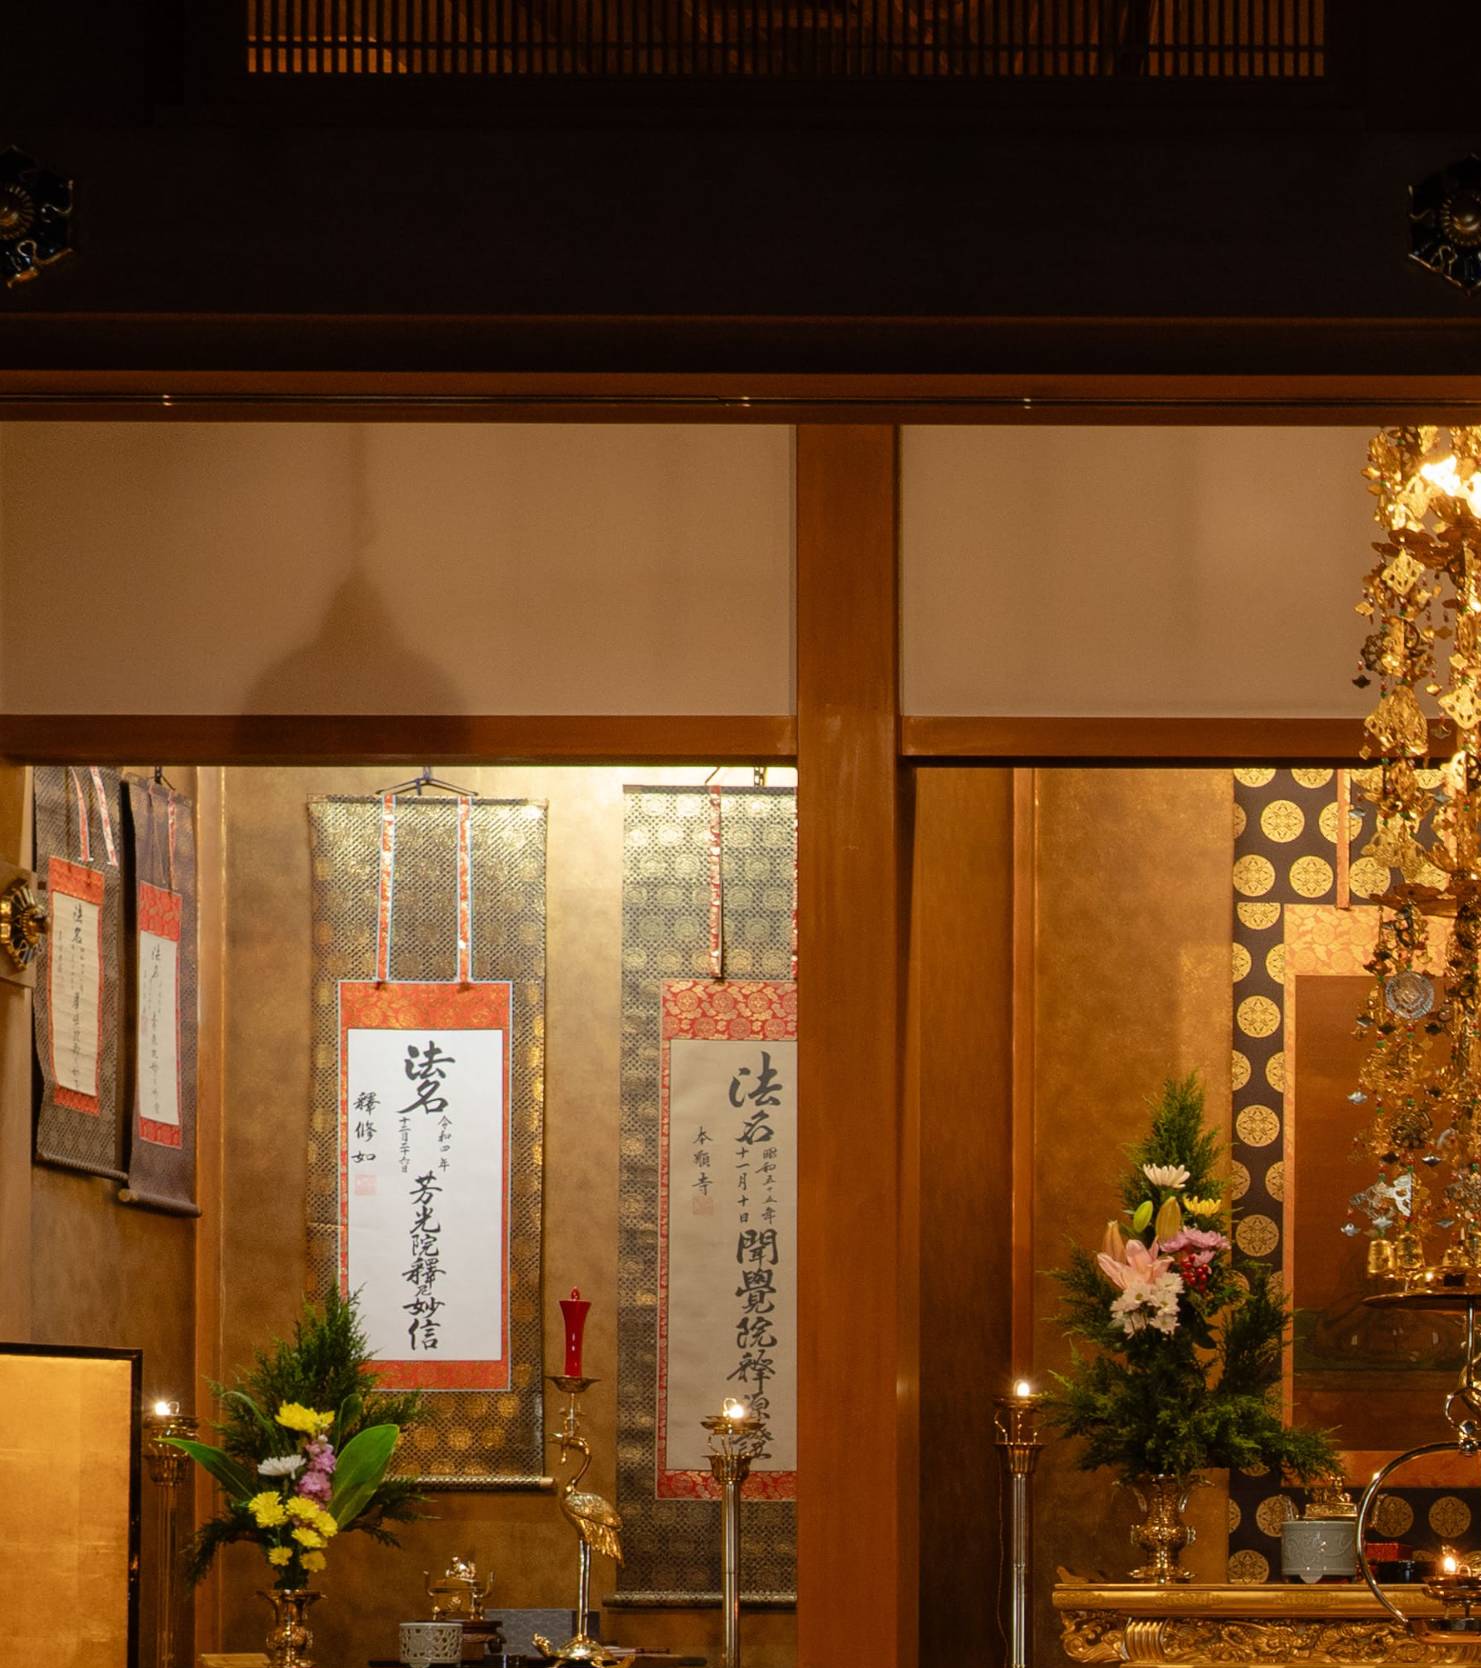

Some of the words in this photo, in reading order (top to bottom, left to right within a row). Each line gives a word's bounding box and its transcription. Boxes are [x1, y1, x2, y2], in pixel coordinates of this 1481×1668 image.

[396, 1040, 456, 1115] 法名
[728, 1050, 783, 1145] 法名
[437, 1114, 453, 1173] 令和四年
[735, 1146, 751, 1223] 十一月十日
[754, 1147, 778, 1226] 昭和五十五年
